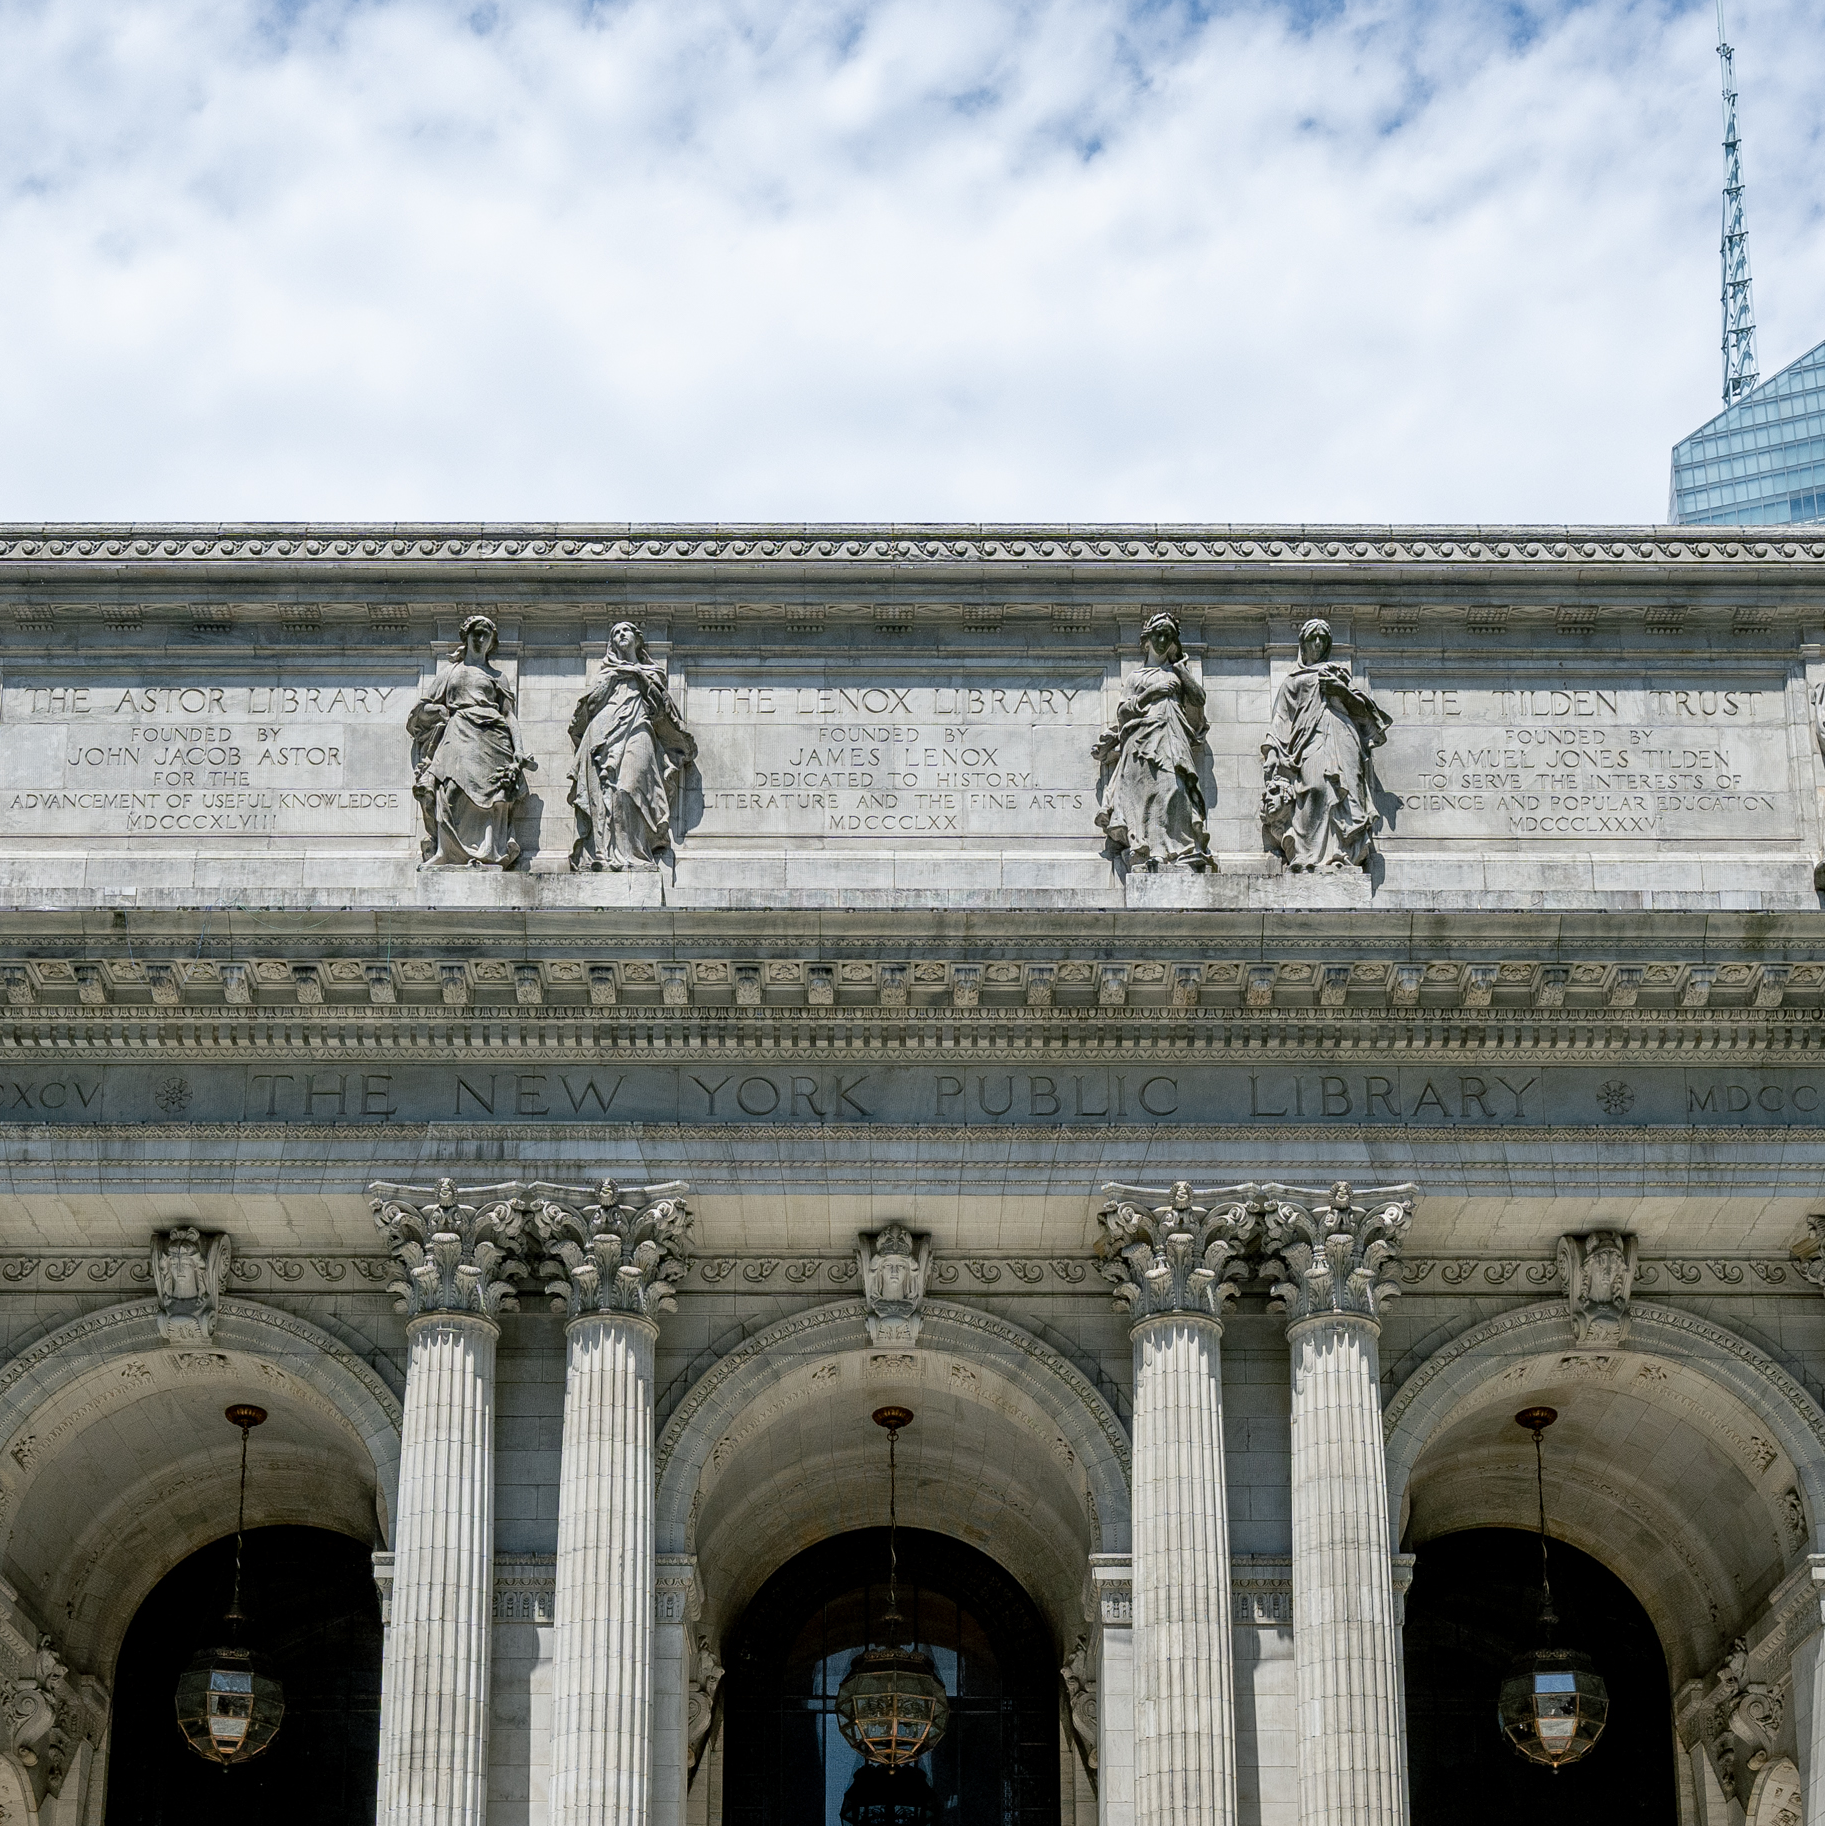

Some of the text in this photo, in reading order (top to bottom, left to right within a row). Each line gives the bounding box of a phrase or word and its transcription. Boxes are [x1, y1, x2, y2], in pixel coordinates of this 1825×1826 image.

[25, 688, 395, 714] THE ASTOR LIBRARY
[708, 688, 1082, 714] THE LENOX LIBRARY
[1393, 690, 1763, 716] THE TILDEN TRUST
[131, 728, 282, 742] FOUNDED BY
[819, 728, 970, 743] FOUNDED BY
[1505, 729, 1653, 745] FOUNDED BY
[68, 748, 342, 766] JOHN JACOB ASTOR
[789, 748, 998, 767] JAMES LENOX
[1435, 750, 1730, 769] SAMUEL JONES TILDEN
[153, 772, 250, 787] FOR THE
[755, 773, 873, 788] DEDICATED
[888, 773, 918, 788] TO
[1418, 774, 1742, 789] TO SERVE THE INTERESTS OF
[10, 794, 398, 809] ADVANCEMENT OF USEFUL KNOWLEDGE
[702, 794, 1083, 809] LITERATURE AND THE FINE ARTS
[1496, 796, 1540, 811] AND
[1551, 796, 1648, 811] POPULAR
[1659, 796, 1775, 811] EDUCATION
[126, 815, 277, 830] MDCCCXLVIII
[251, 1074, 1541, 1118] THE NEW YORK PUBLIC LIBRARY
